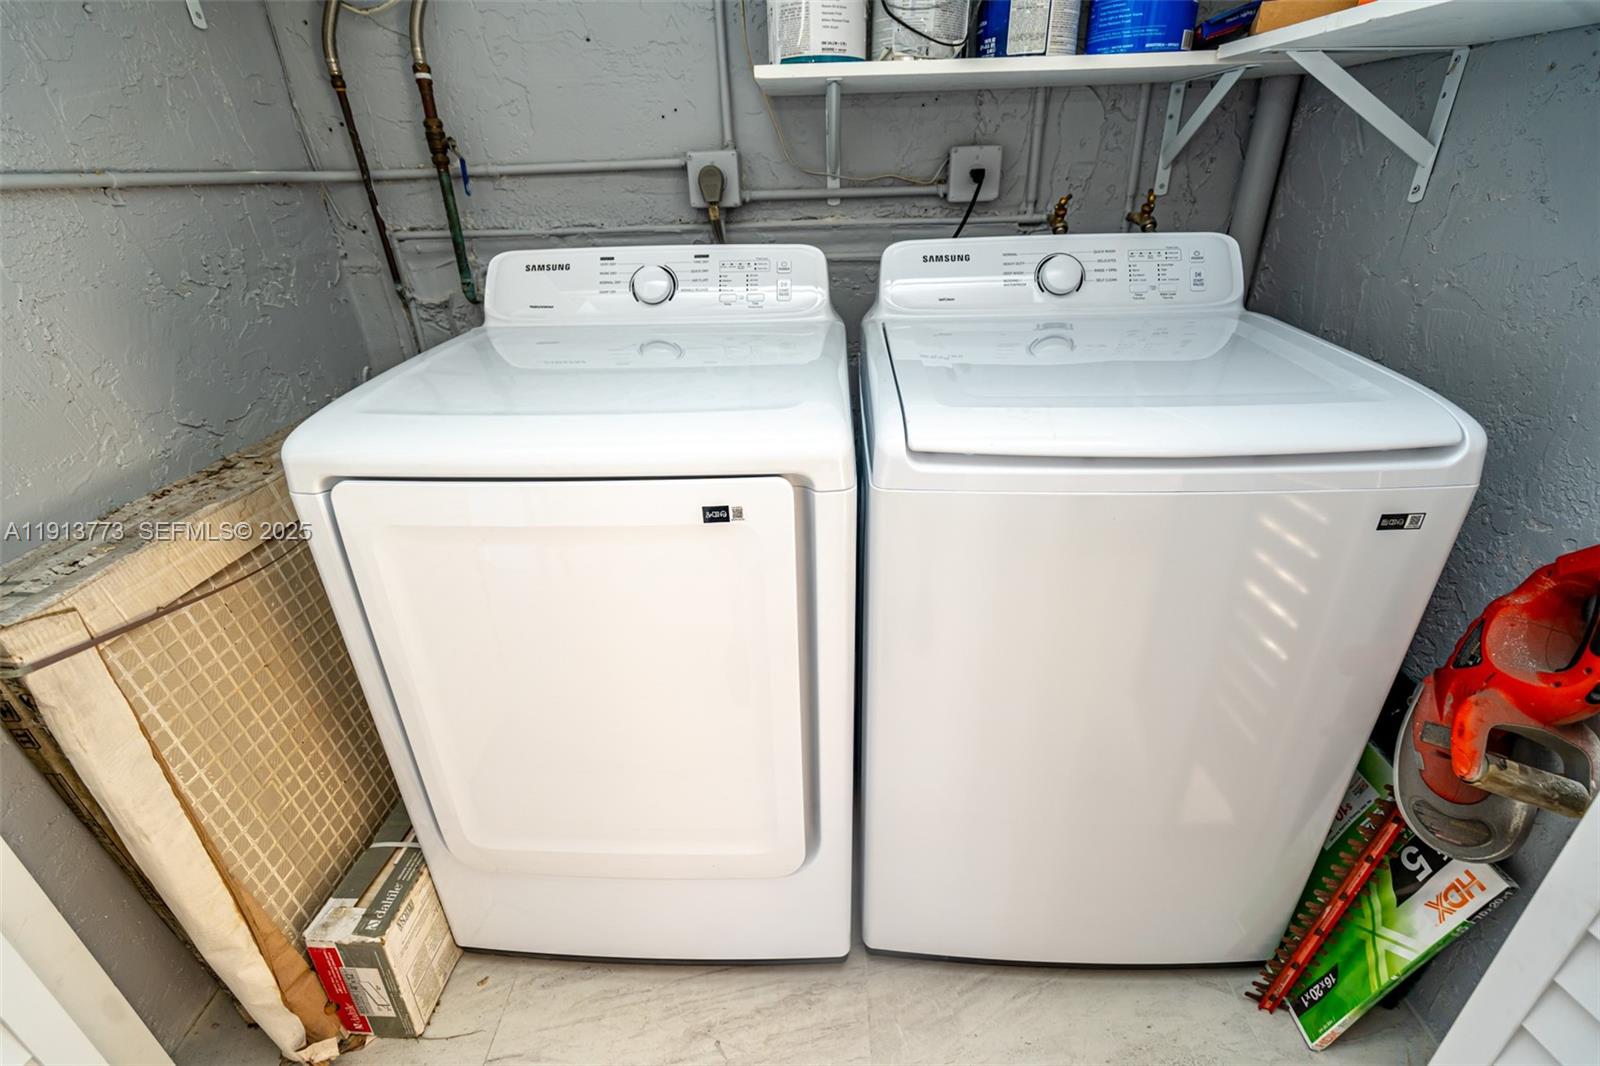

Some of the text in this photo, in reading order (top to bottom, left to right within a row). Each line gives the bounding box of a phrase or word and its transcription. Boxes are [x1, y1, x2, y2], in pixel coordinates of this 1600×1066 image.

[525, 263, 571, 272] SAMSUNG
[922, 253, 972, 263] SAMSUNG
[1401, 845, 1433, 882] 5
[375, 882, 404, 919] daltile
[1424, 869, 1487, 925] HDX
[1300, 973, 1337, 1008] 16x20x1
